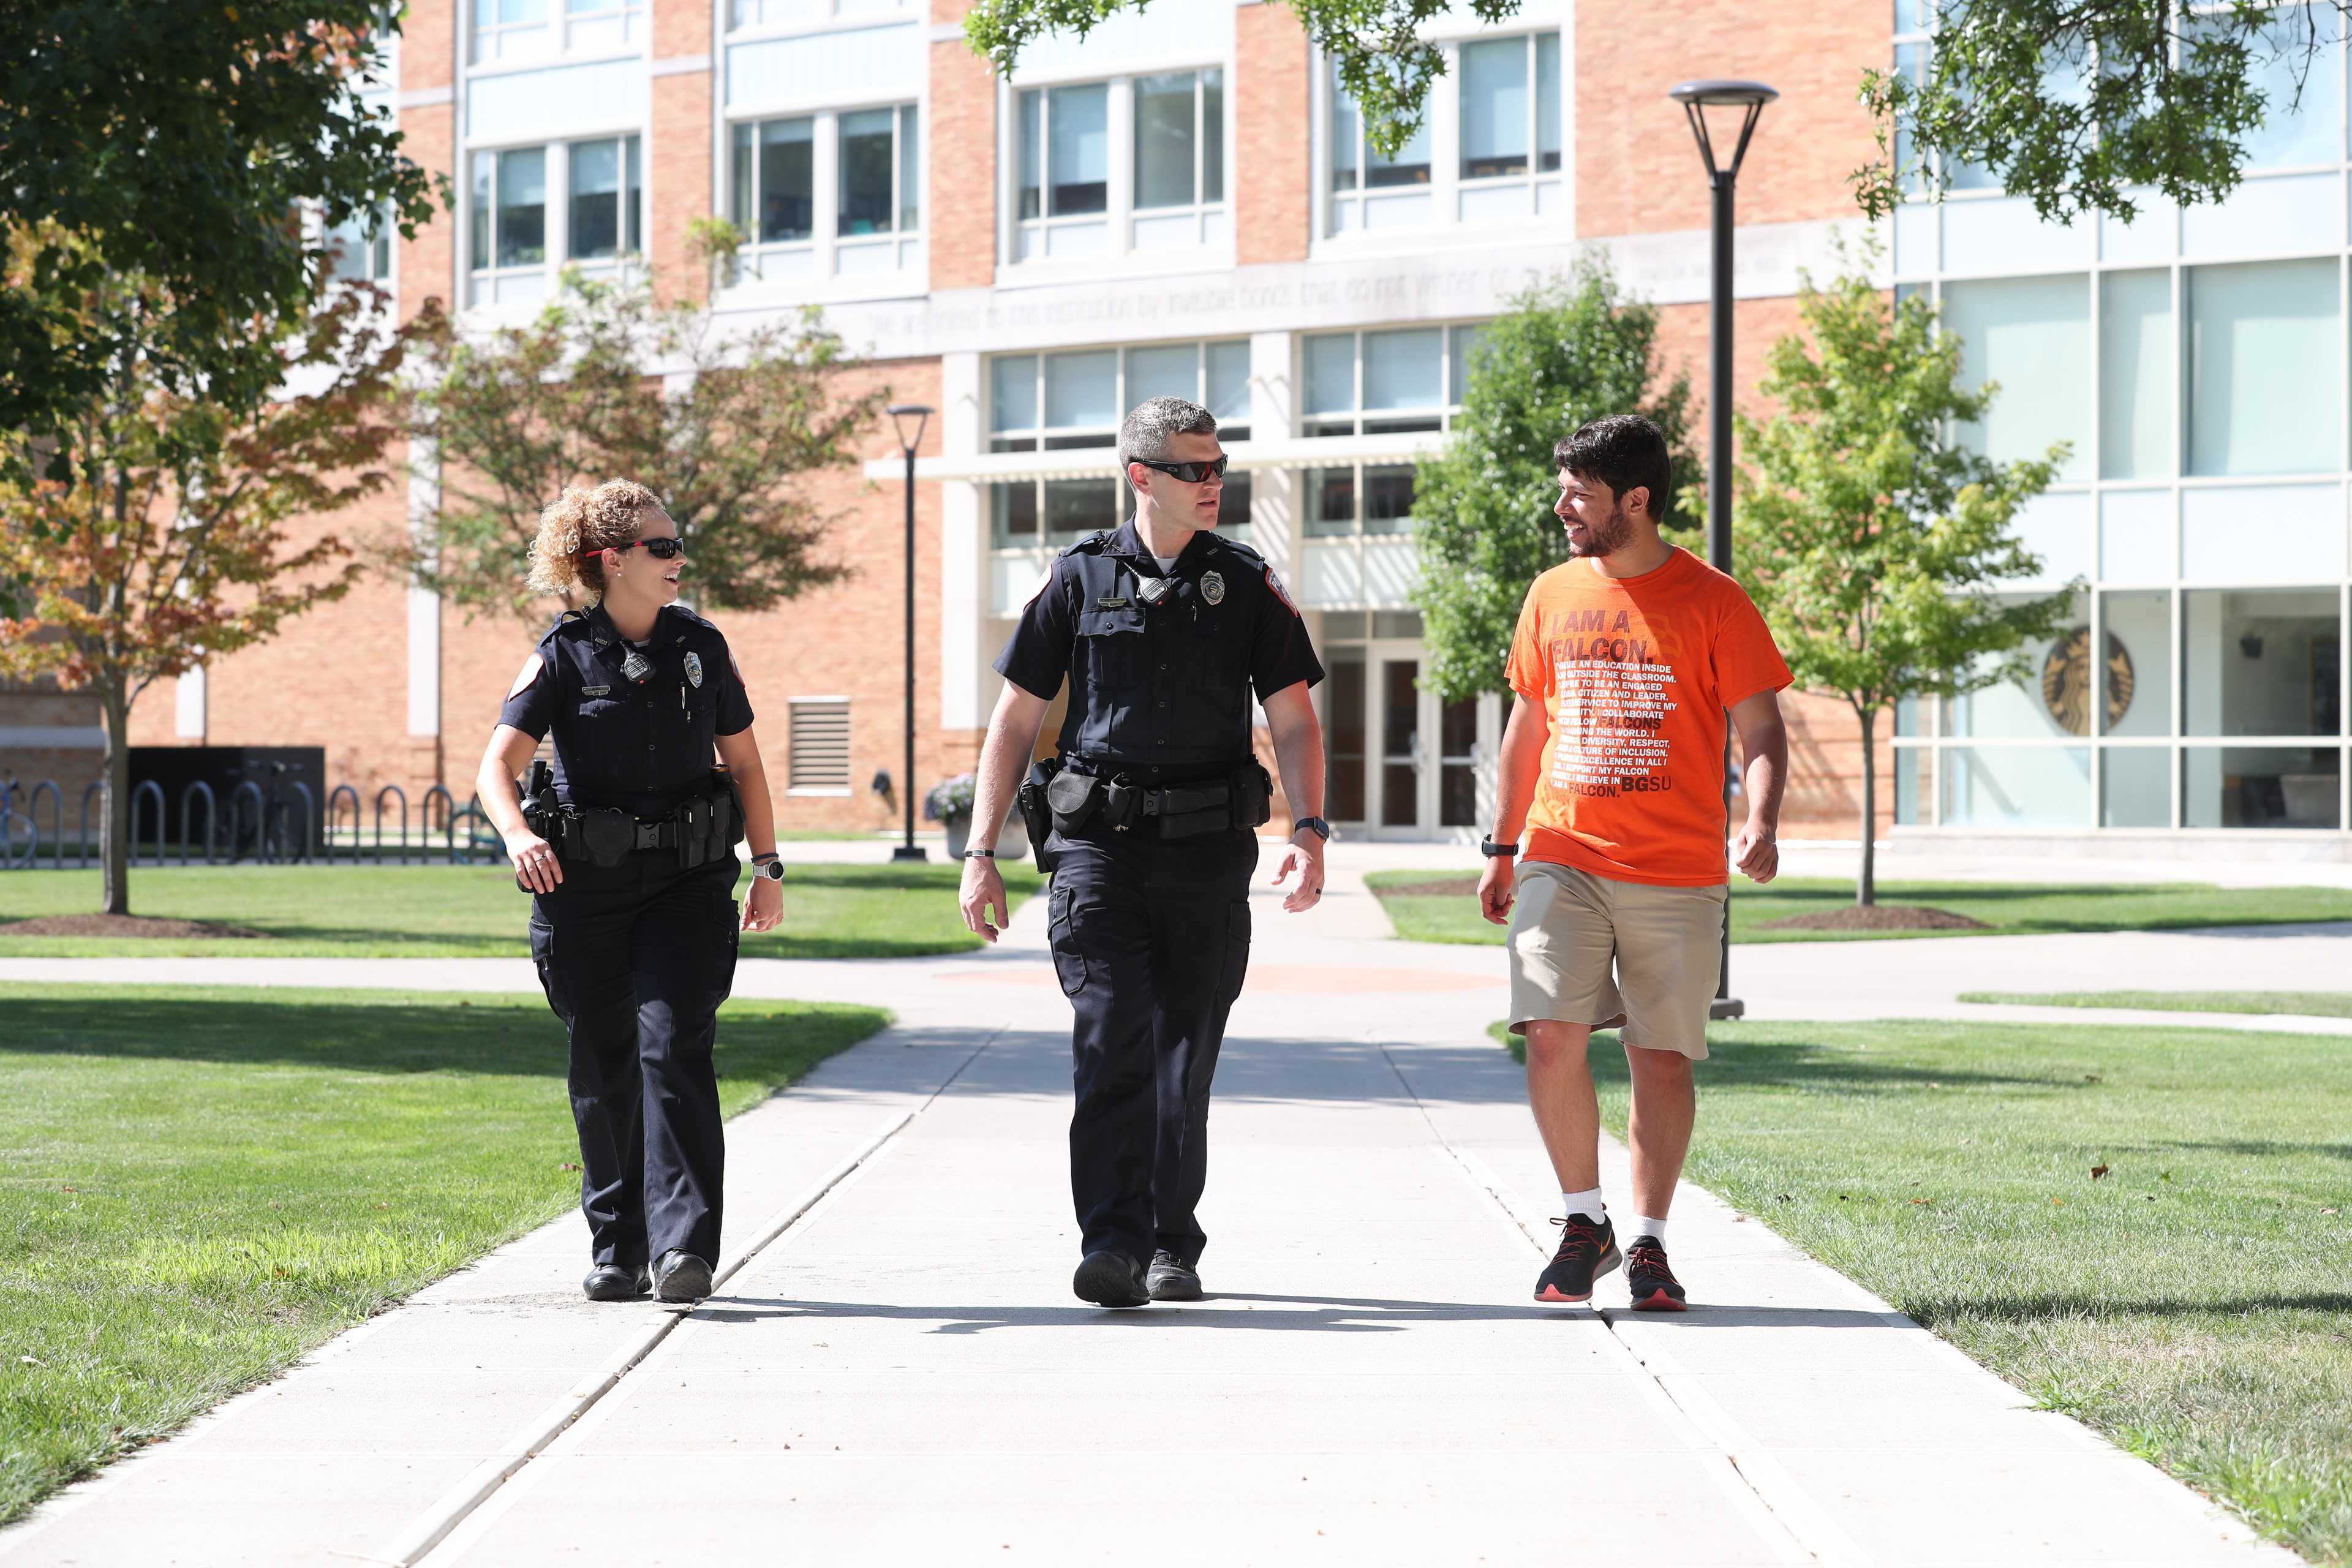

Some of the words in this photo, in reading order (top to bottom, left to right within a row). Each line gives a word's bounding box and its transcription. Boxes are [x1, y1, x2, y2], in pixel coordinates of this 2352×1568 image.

[1552, 614, 1559, 636] I
[1563, 609, 1605, 632] AM
[1611, 610, 1630, 633] A
[1553, 638, 1653, 664] FALCON.
[1578, 660, 1590, 668] AN
[1593, 661, 1640, 671] EDUCATION
[1642, 663, 1672, 674] INSIDE
[1602, 671, 1619, 679] THE
[1621, 672, 1676, 683] CLASSROOM.
[1622, 681, 1662, 691] ENGAGED
[1578, 688, 1609, 698] CITIZEN
[1611, 690, 1630, 699] AND
[1632, 692, 1668, 701] LEADER.
[1621, 700, 1662, 709] IMPROVE
[1602, 709, 1664, 719] COLLABORATE
[1599, 716, 1661, 729] FALCONS
[1581, 737, 1627, 747] DIVERSITY,
[1629, 739, 1670, 749] RESPECT,
[1619, 748, 1668, 757] INCLUSION.
[1580, 755, 1633, 766] EXCELLENCE
[1566, 763, 1597, 774] SUPPORT
[1576, 774, 1608, 784] BELIEVE
[1621, 775, 1672, 792] BGSU
[1569, 782, 1620, 797] FALCON.
